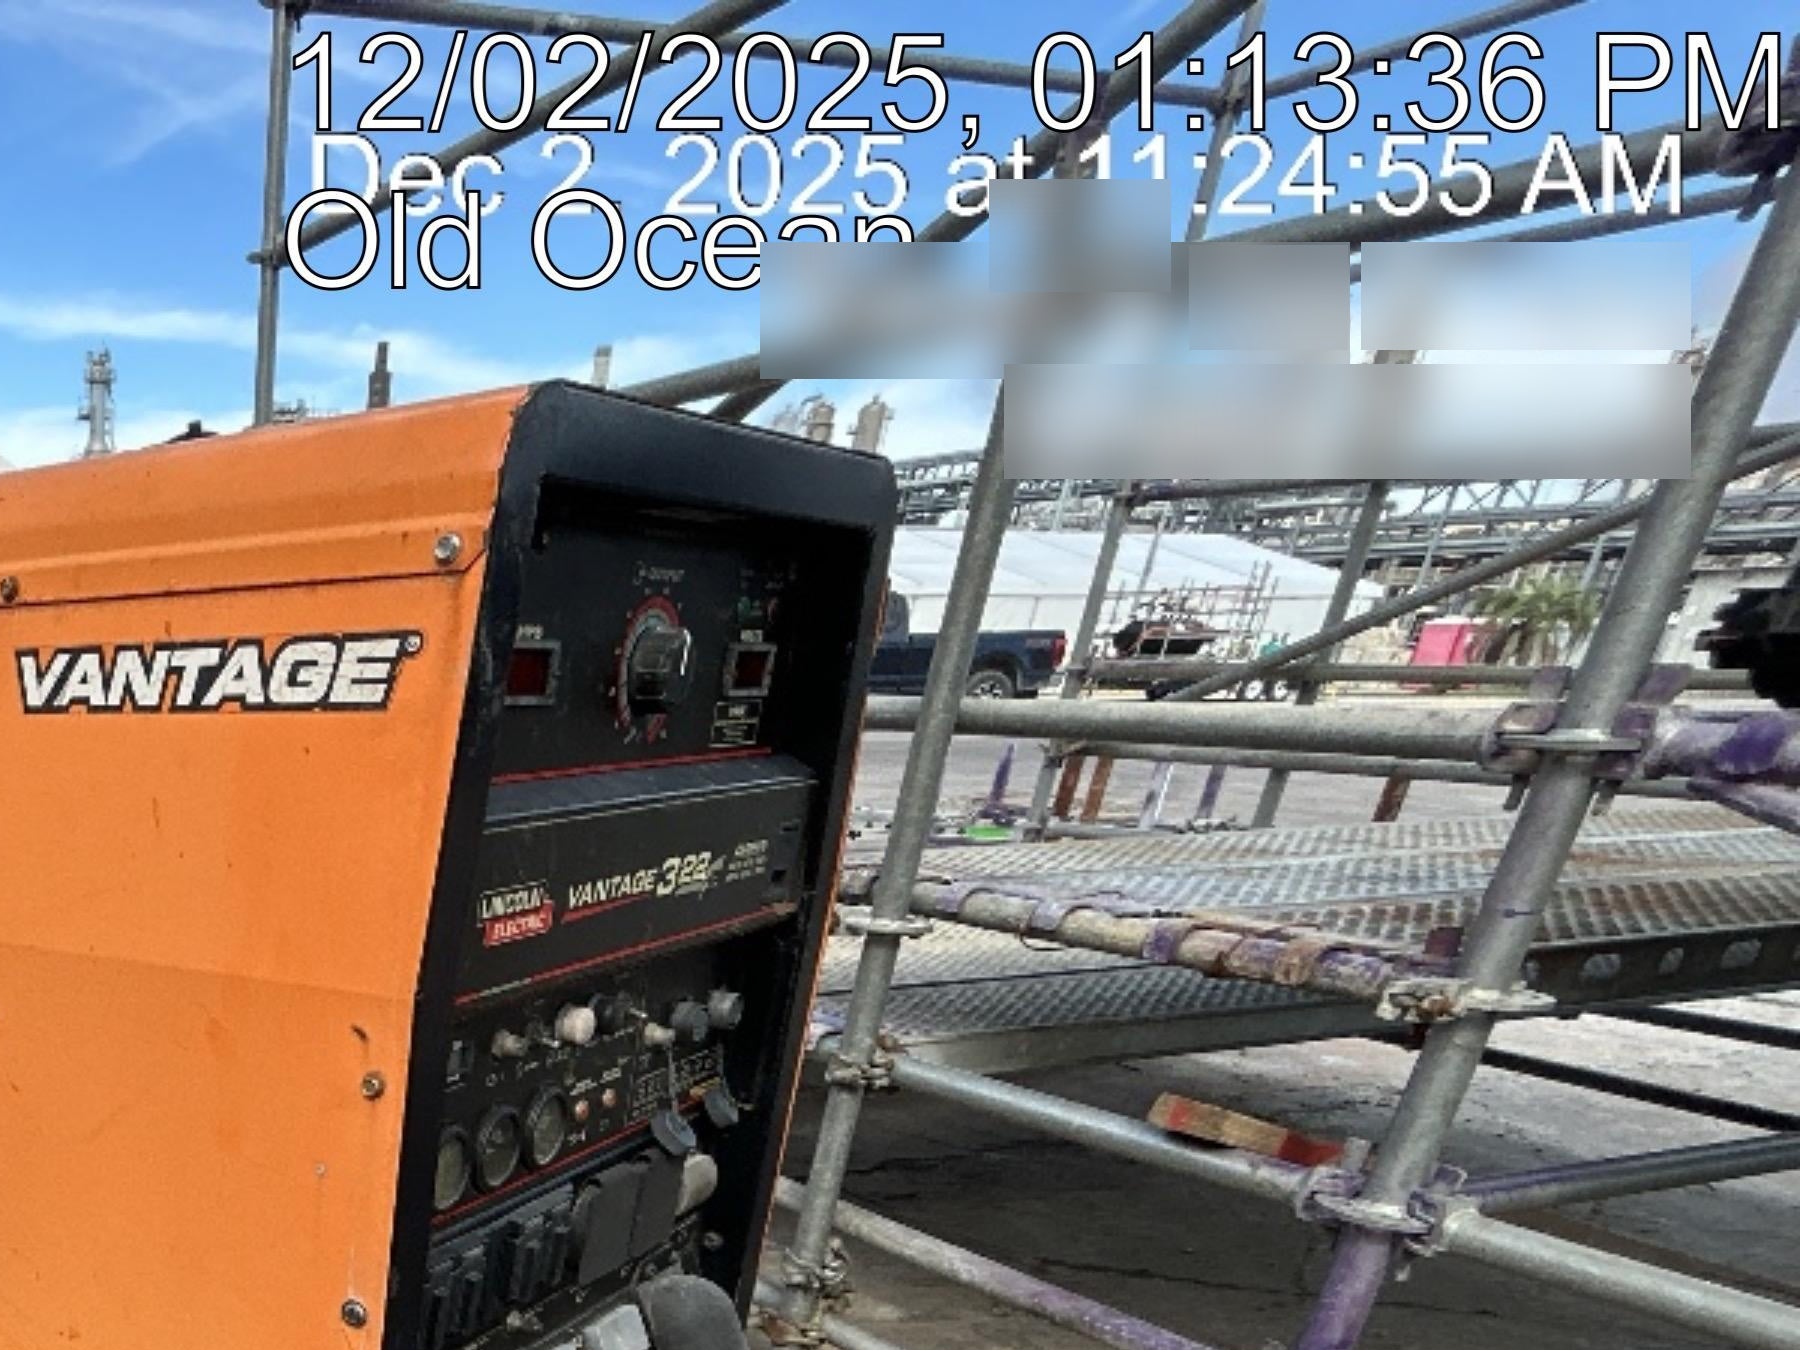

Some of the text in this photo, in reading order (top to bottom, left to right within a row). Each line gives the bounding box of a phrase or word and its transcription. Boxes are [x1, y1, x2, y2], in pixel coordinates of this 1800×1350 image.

[16, 634, 403, 711] VANTAGE
[569, 868, 657, 908] VANTAGE
[656, 851, 712, 897] 322
